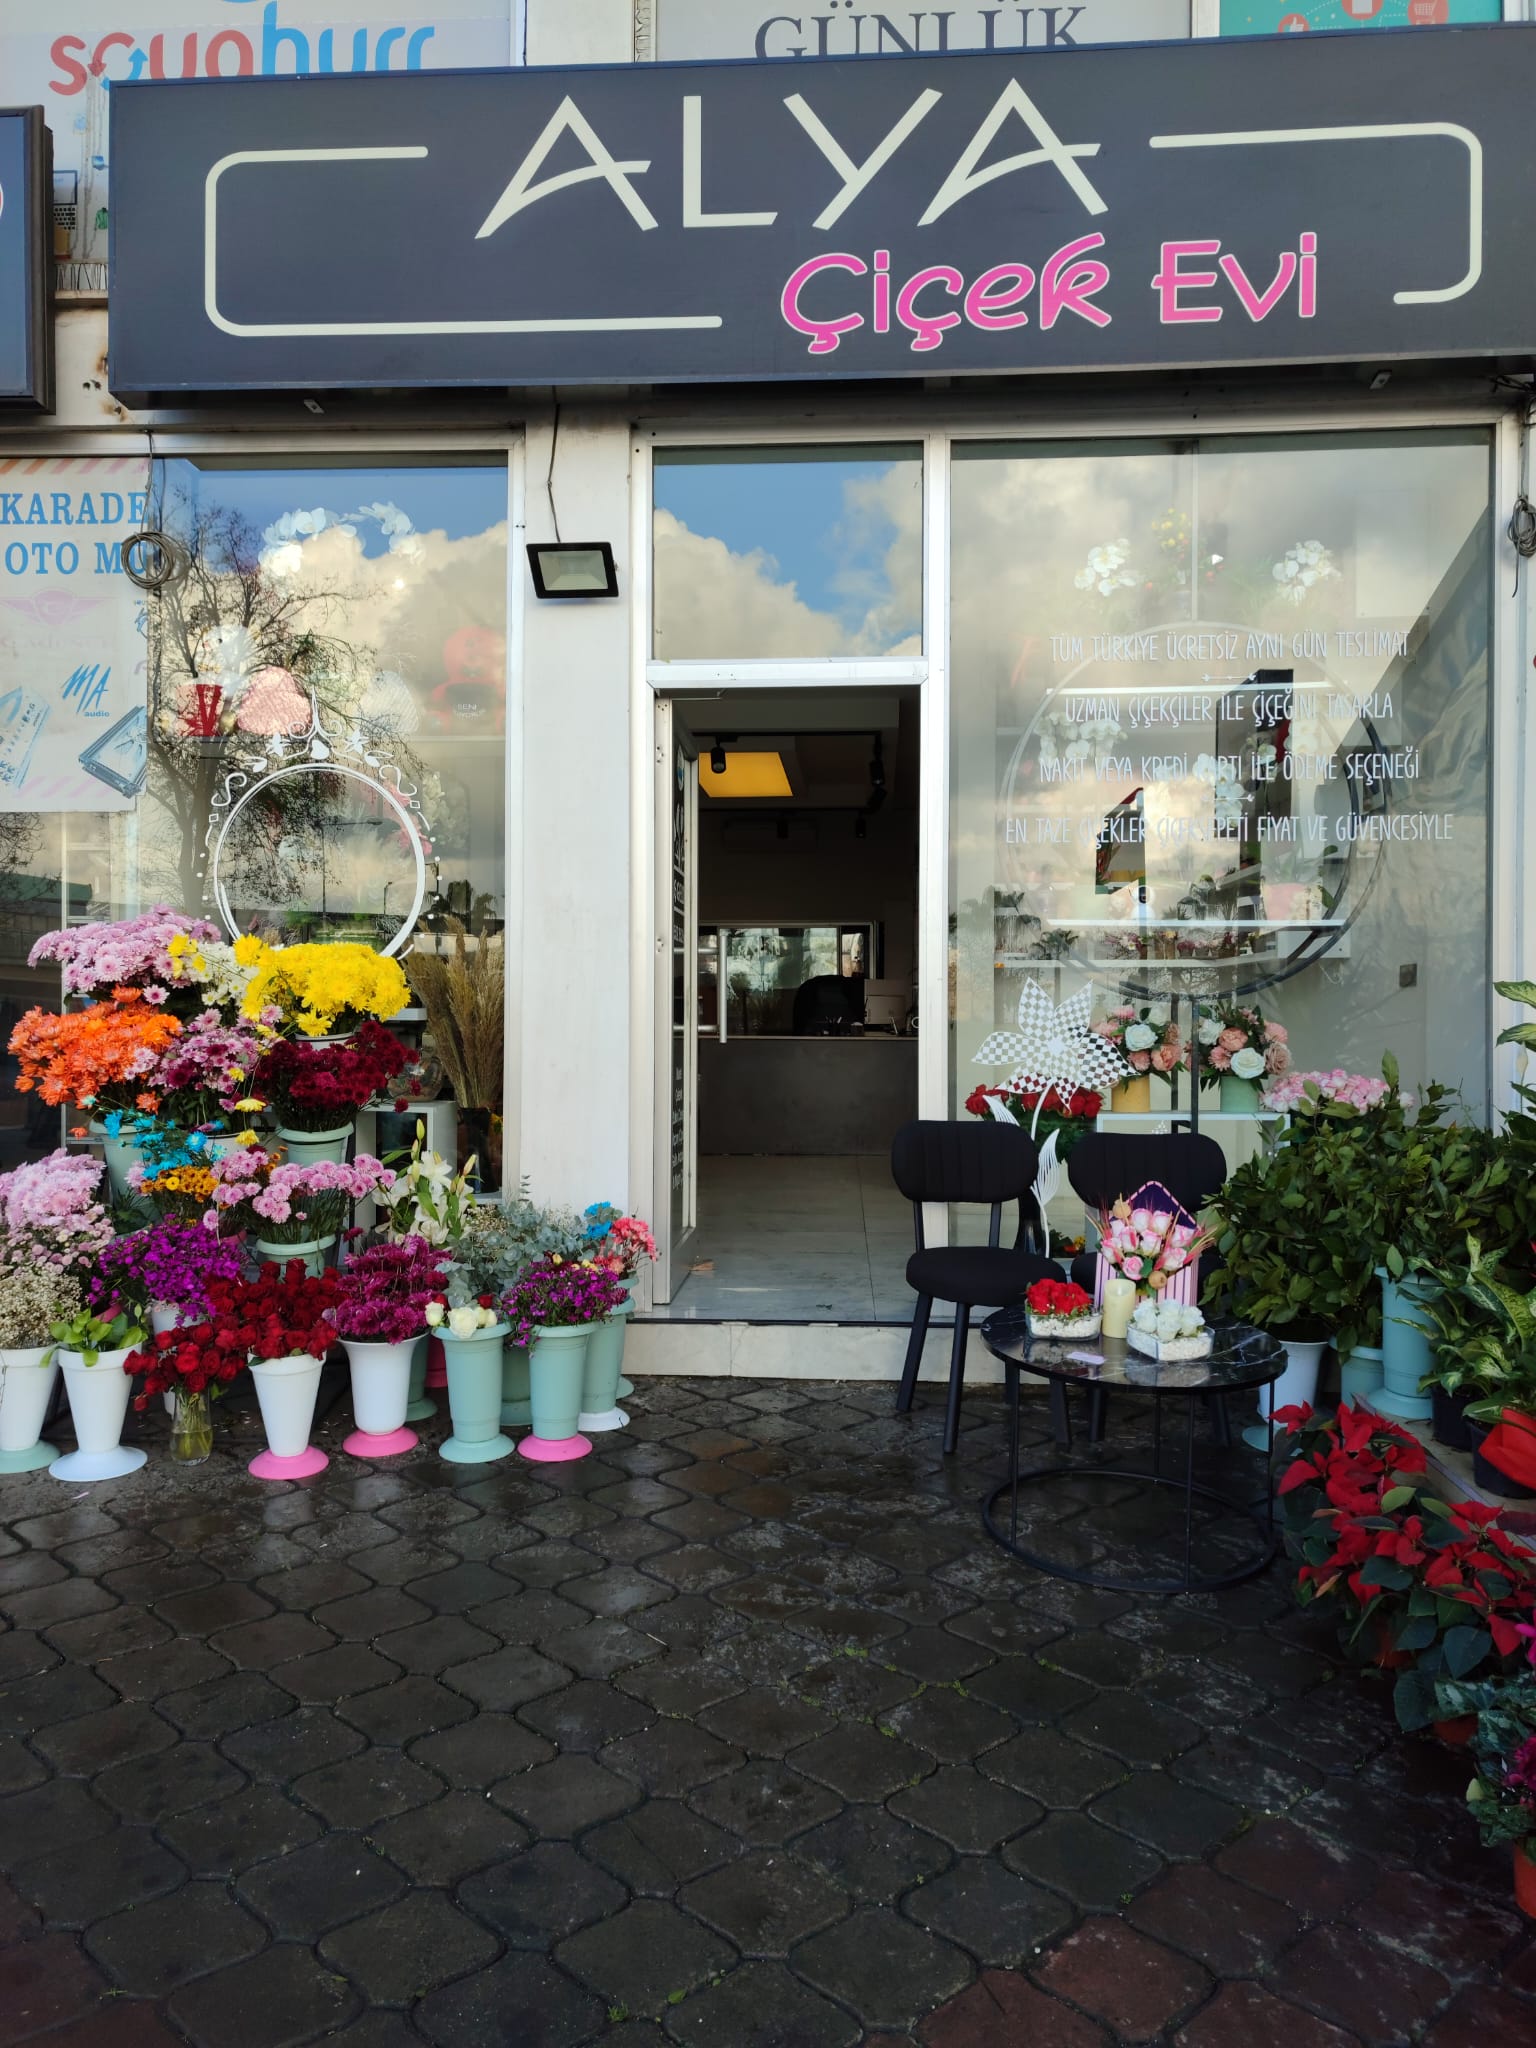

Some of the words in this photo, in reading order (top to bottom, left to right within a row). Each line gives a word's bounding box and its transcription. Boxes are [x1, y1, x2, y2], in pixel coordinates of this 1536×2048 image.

[475, 78, 1109, 239] ALYA
[780, 232, 1112, 354] Çiçek
[1150, 232, 1318, 324] Evi
[5, 541, 79, 575] OTO
[1050, 632, 1084, 662] TÜM
[1092, 632, 1159, 662] TÜRKİYE
[1167, 631, 1238, 660] ÜCRETSİZ
[1246, 633, 1283, 659] AYNI
[1292, 630, 1327, 658] GÜN
[1335, 630, 1411, 657] TESLİMAT
[84, 710, 110, 718] audio
[1065, 696, 1120, 722] UZMAN
[1327, 692, 1393, 720] TASARLA
[1095, 756, 1133, 783] VEYA
[1141, 752, 1187, 782] KREDİ
[1283, 751, 1338, 780] ÖDEME
[1346, 746, 1419, 785] SEÇENEĞİ
[1006, 818, 1028, 844] EN
[1036, 817, 1074, 844] TAZE
[1257, 812, 1300, 842] FİYAT
[1307, 815, 1329, 841] VE
[1336, 811, 1454, 842] GÜVENCESİYLE
